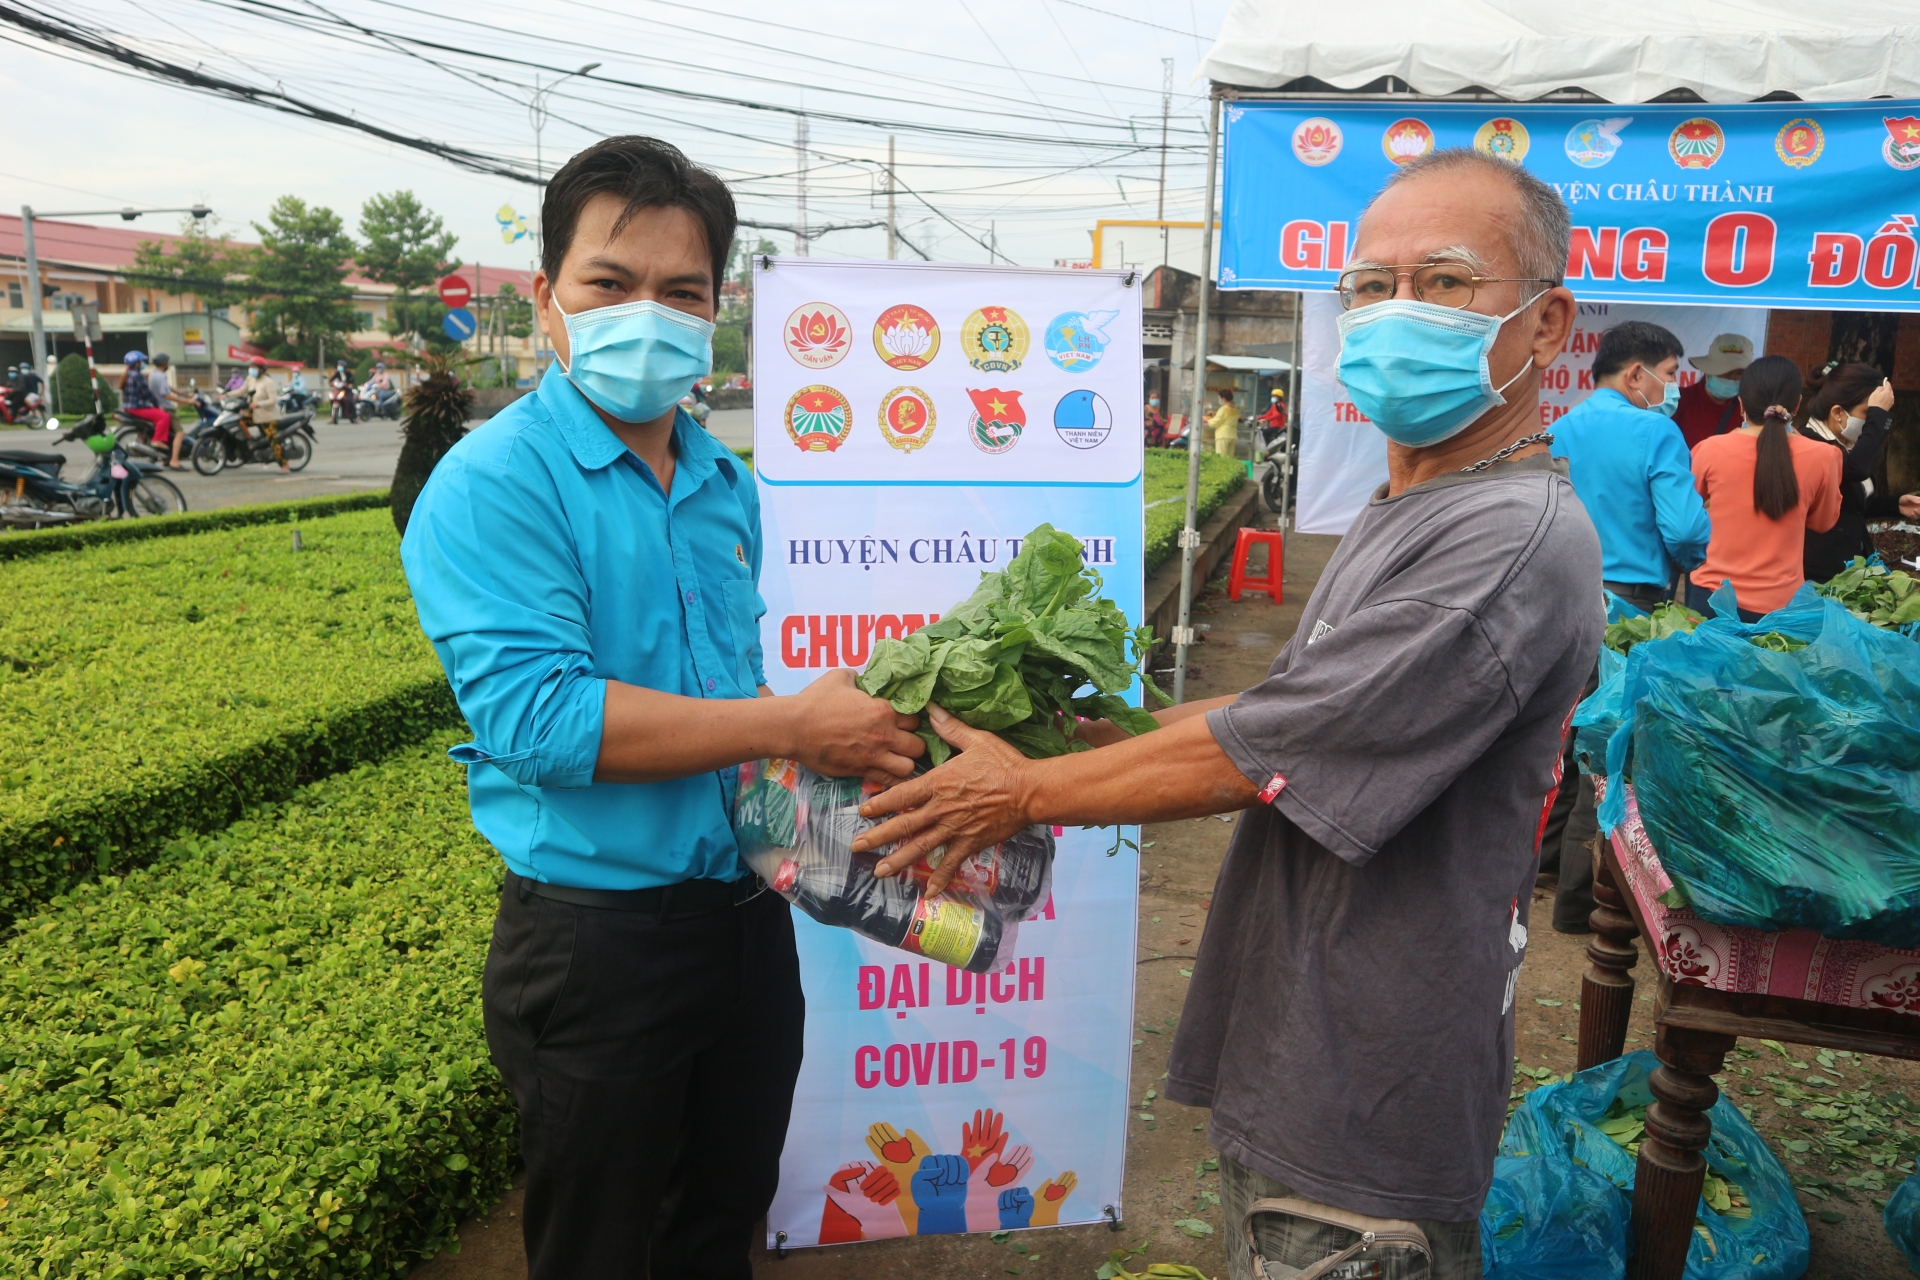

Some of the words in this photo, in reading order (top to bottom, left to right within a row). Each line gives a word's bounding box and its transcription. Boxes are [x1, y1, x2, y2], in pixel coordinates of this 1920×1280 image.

[1548, 180, 1601, 204] YỆN
[1607, 179, 1678, 202] CHÂU
[1685, 179, 1775, 203] THÀNH
[1280, 219, 1356, 271] GI
[1564, 226, 1670, 282] NG
[1808, 214, 1920, 289] ĐỒ
[788, 535, 900, 571] HUYỆN
[909, 530, 997, 563] CHÂU
[1006, 539, 1114, 563] TNH
[857, 963, 930, 1019] ĐẠI
[945, 957, 1045, 1015] DỊCH
[854, 1035, 1048, 1089] COVID-19
